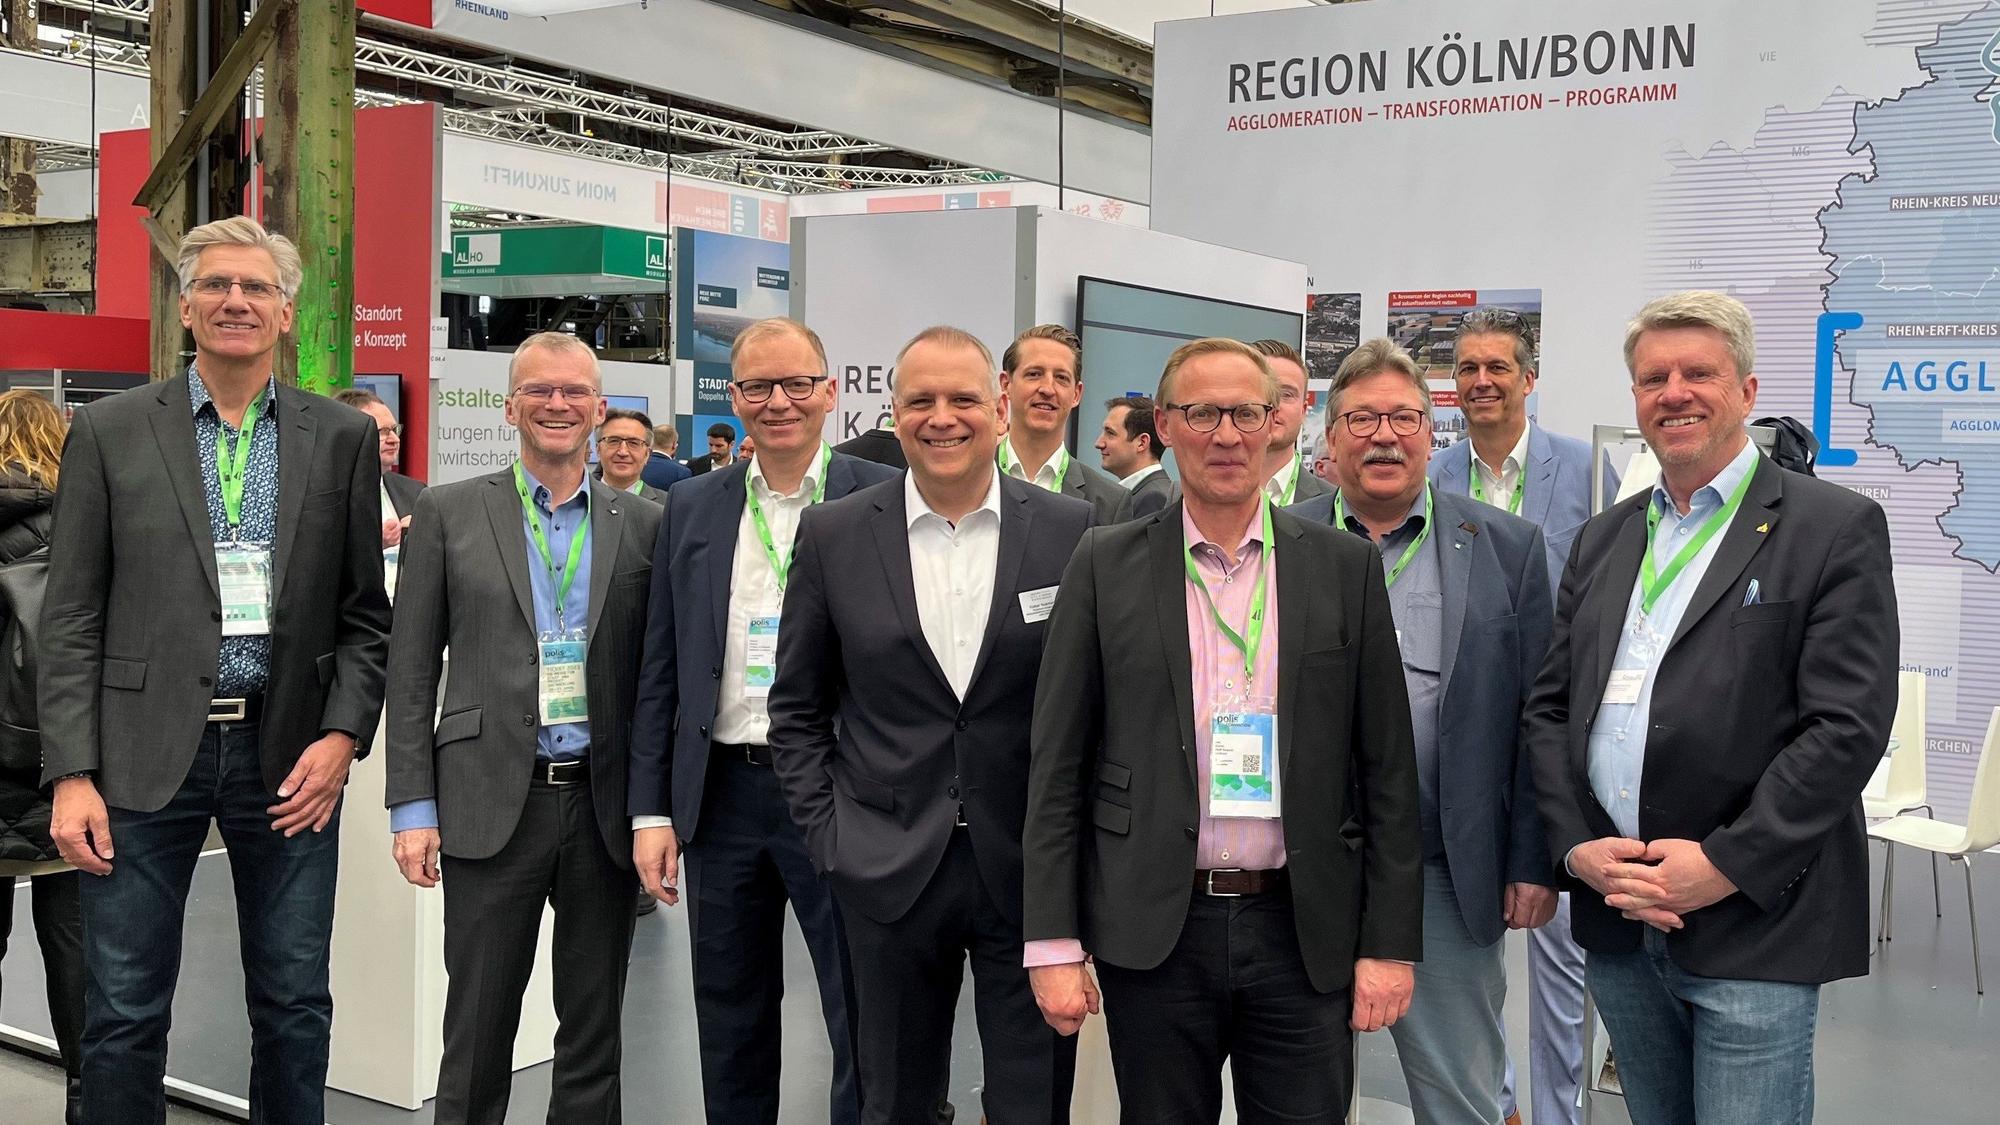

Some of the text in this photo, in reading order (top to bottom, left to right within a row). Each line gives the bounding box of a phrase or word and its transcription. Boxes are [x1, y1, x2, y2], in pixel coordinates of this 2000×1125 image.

[455, 0, 509, 20] RHEINLAND
[1229, 23, 1697, 103] REGION KÖLN/BONN
[1759, 51, 1777, 61] VIE
[1227, 106, 1363, 131] AGGLOMERATION
[1383, 93, 1542, 120] TRANSFORMATION
[1566, 83, 1678, 108] PROGRAMM
[1792, 146, 1811, 157] MG
[1892, 195, 1968, 209] RHEIN-KREIS
[456, 251, 483, 264] ALHO
[355, 304, 402, 321] Standort
[1888, 324, 1997, 337] RHEIN-ERFT-KREIS
[355, 330, 407, 350] e Konzept
[845, 366, 893, 393] RE
[1882, 361, 1996, 392] AGGL
[438, 388, 504, 408] estalte
[699, 391, 724, 402] Doppelte
[498, 425, 518, 441] für
[751, 617, 770, 627] polis
[1217, 714, 1239, 724] polis
